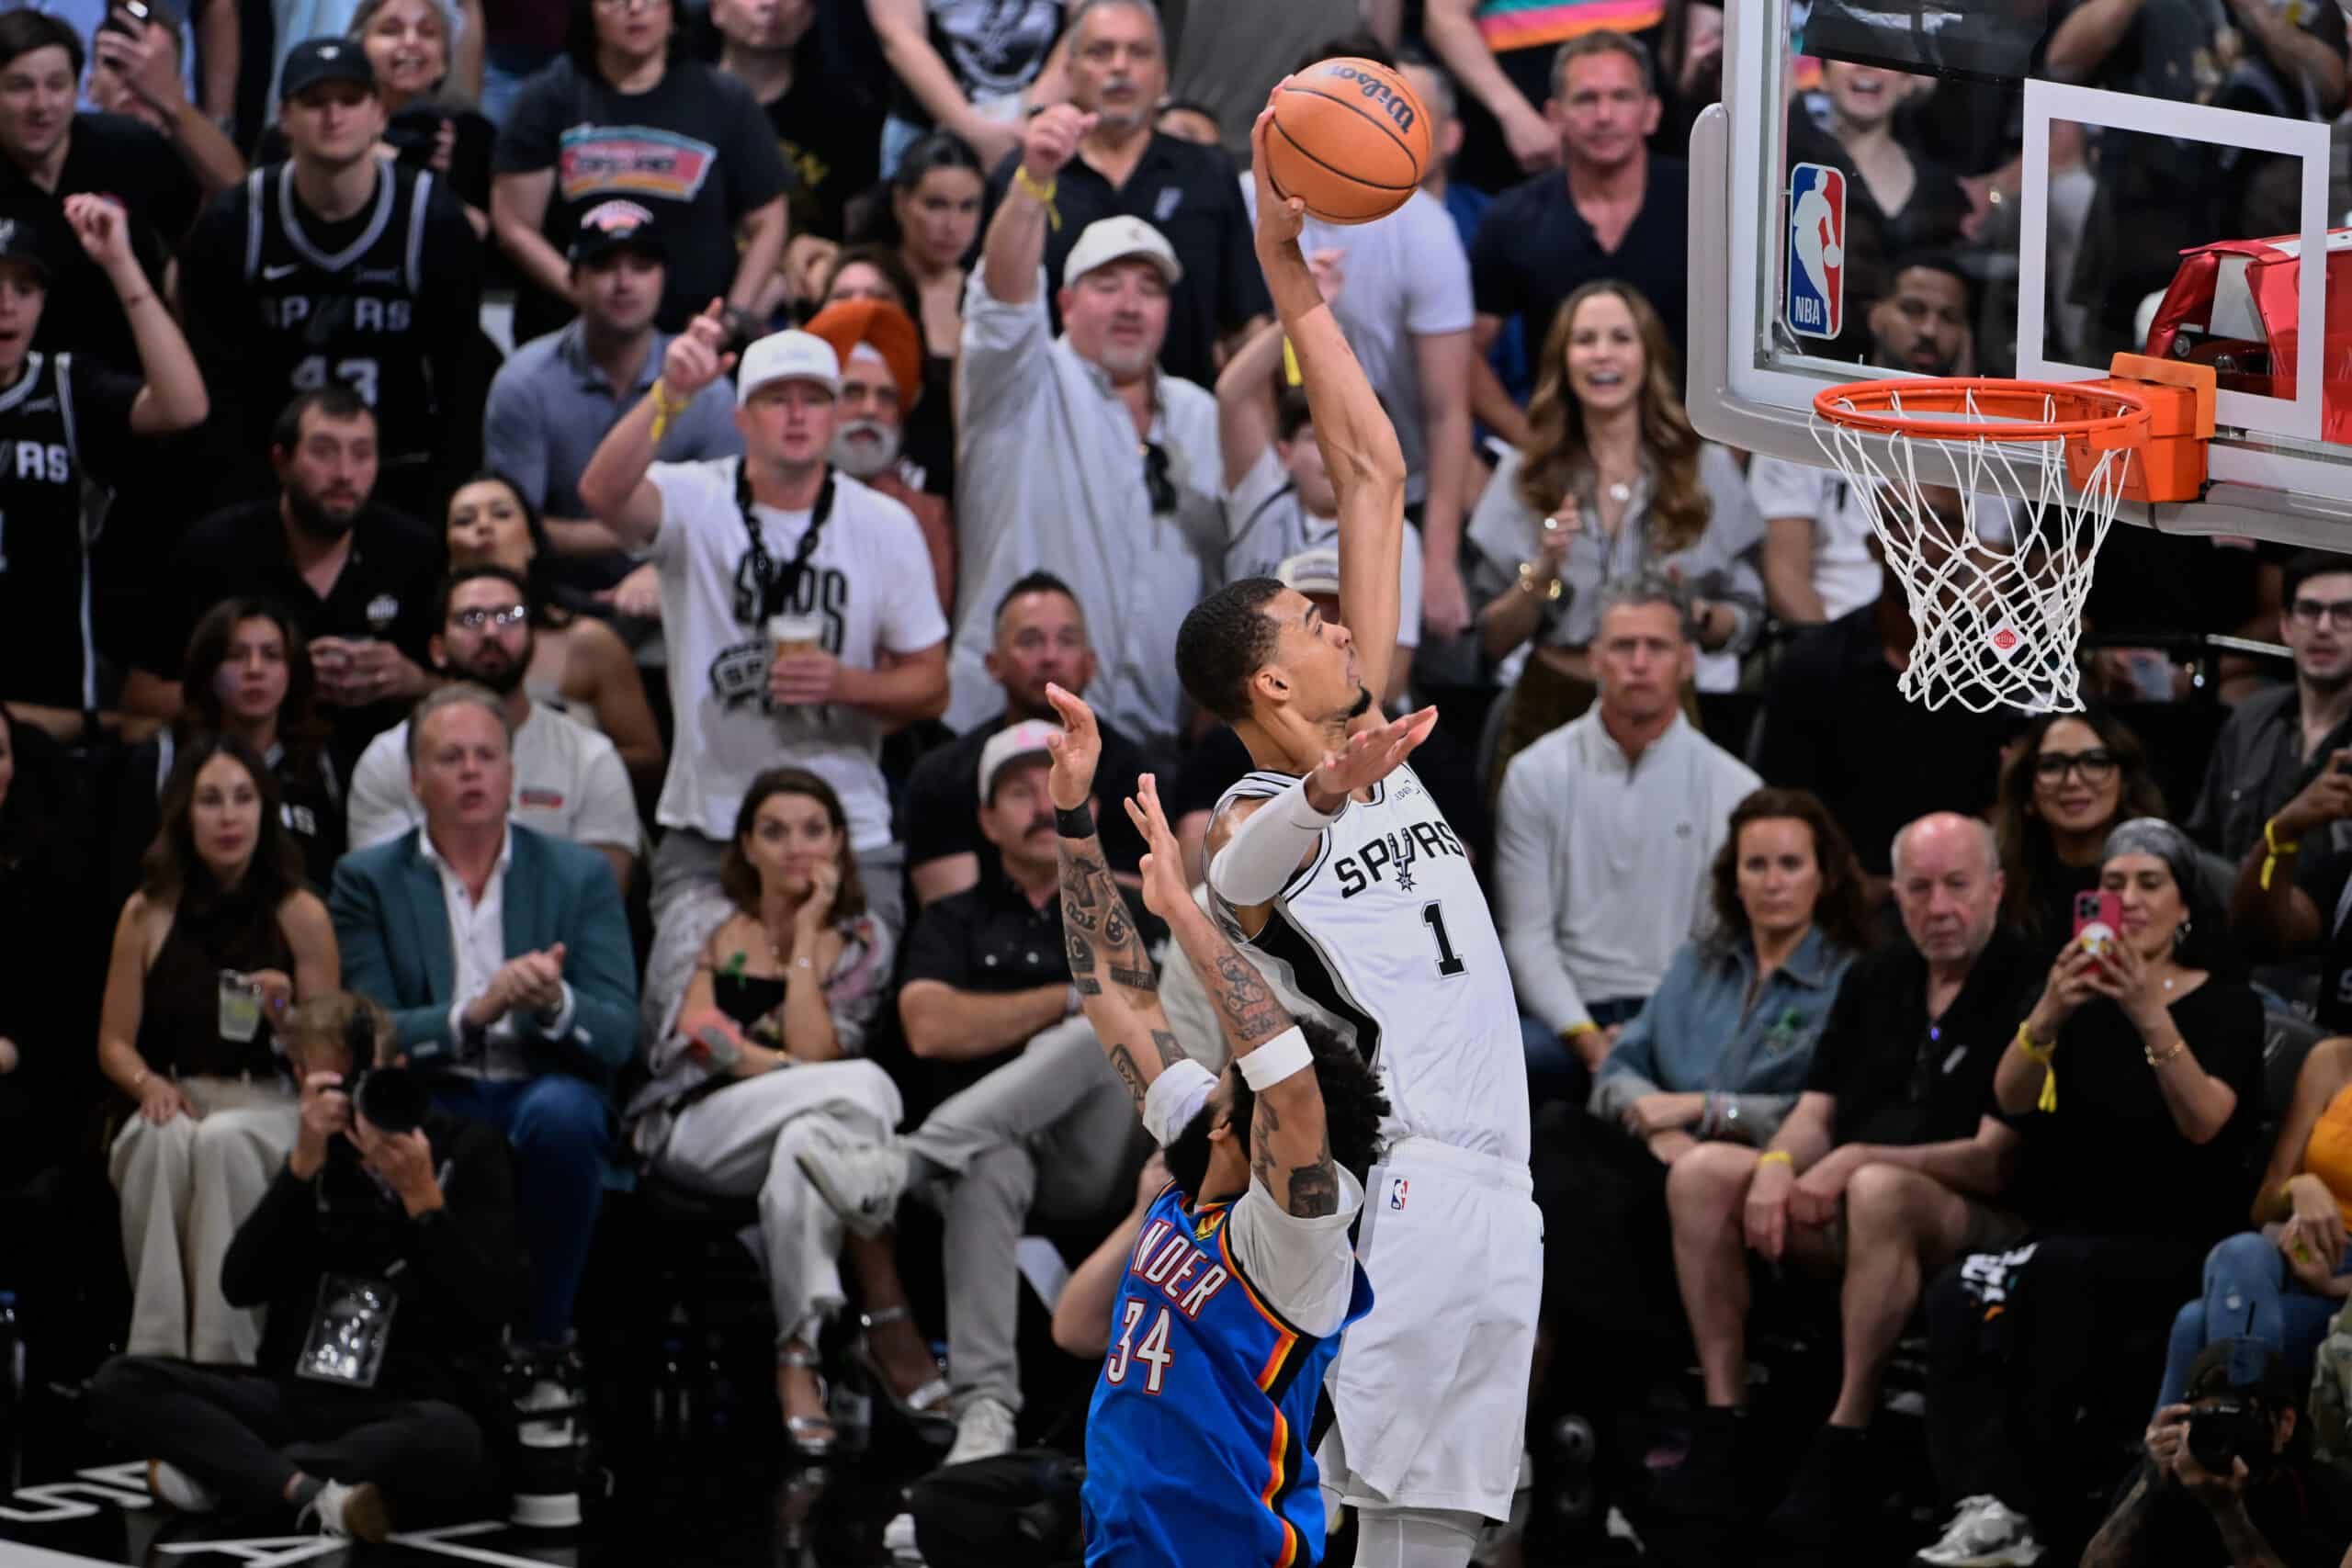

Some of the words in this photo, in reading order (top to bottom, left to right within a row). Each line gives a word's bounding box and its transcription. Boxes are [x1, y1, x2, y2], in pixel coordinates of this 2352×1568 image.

[1794, 295, 1821, 326] NBA
[1334, 820, 1466, 899] SPURS
[1421, 899, 1470, 978] 1
[1106, 1297, 1175, 1396] 34
